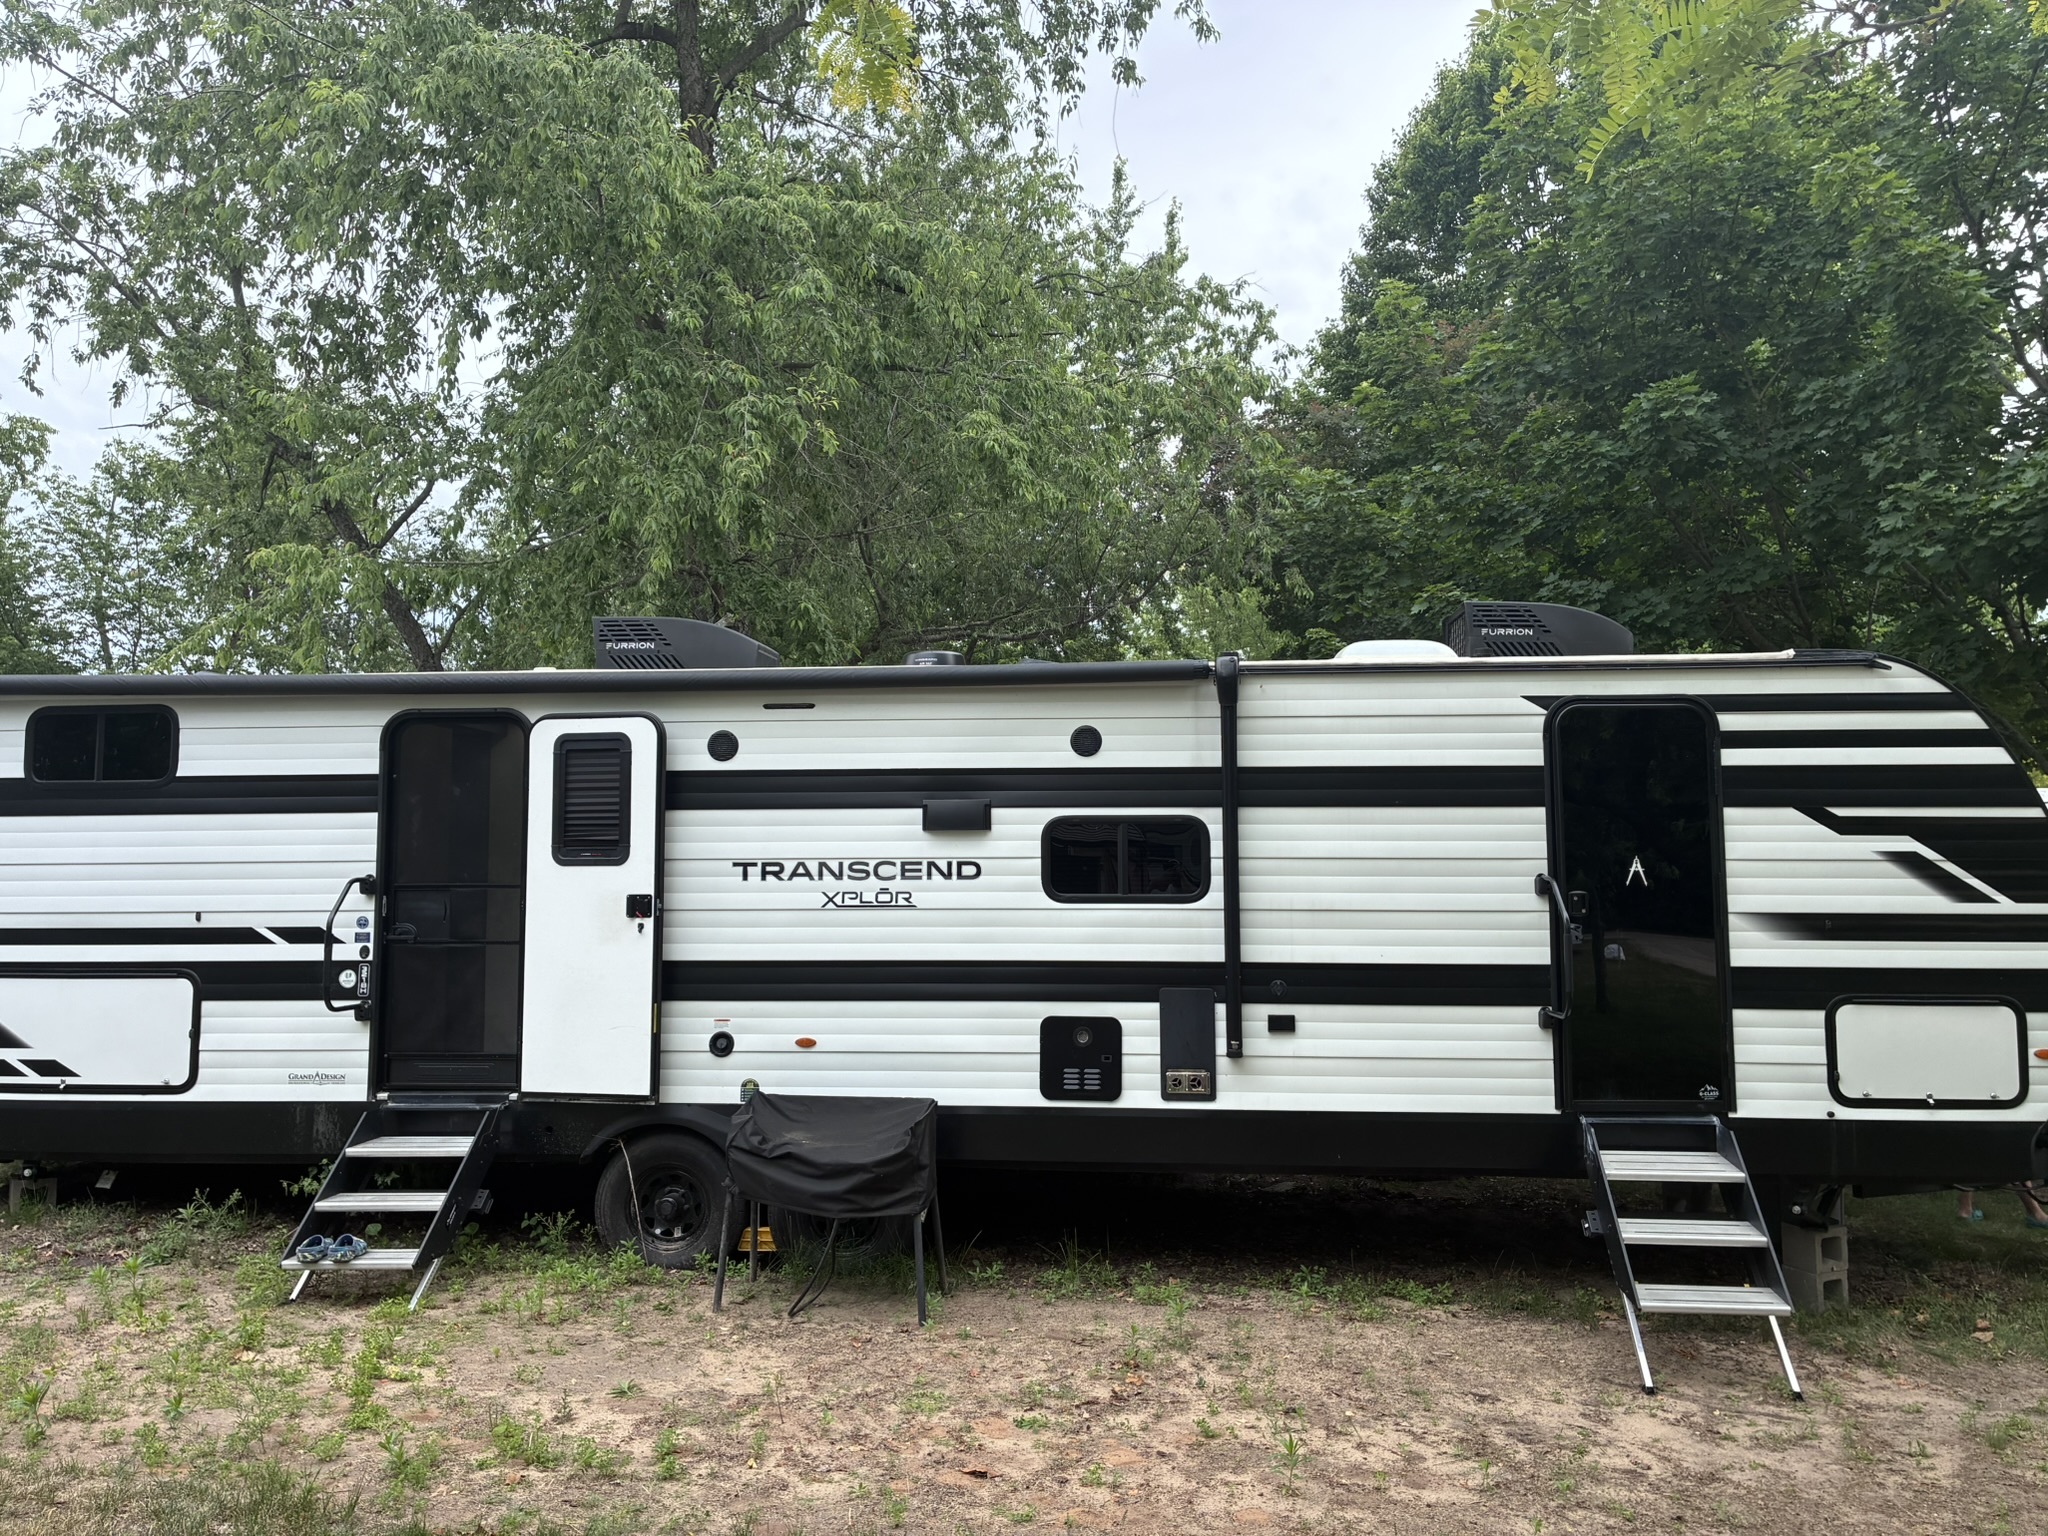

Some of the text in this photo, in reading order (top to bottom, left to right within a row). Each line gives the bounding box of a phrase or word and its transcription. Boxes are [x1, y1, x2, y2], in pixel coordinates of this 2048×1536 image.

[1481, 628, 1533, 636] FURRION
[605, 642, 655, 650] FURRION
[732, 860, 982, 881] TRANSCEND
